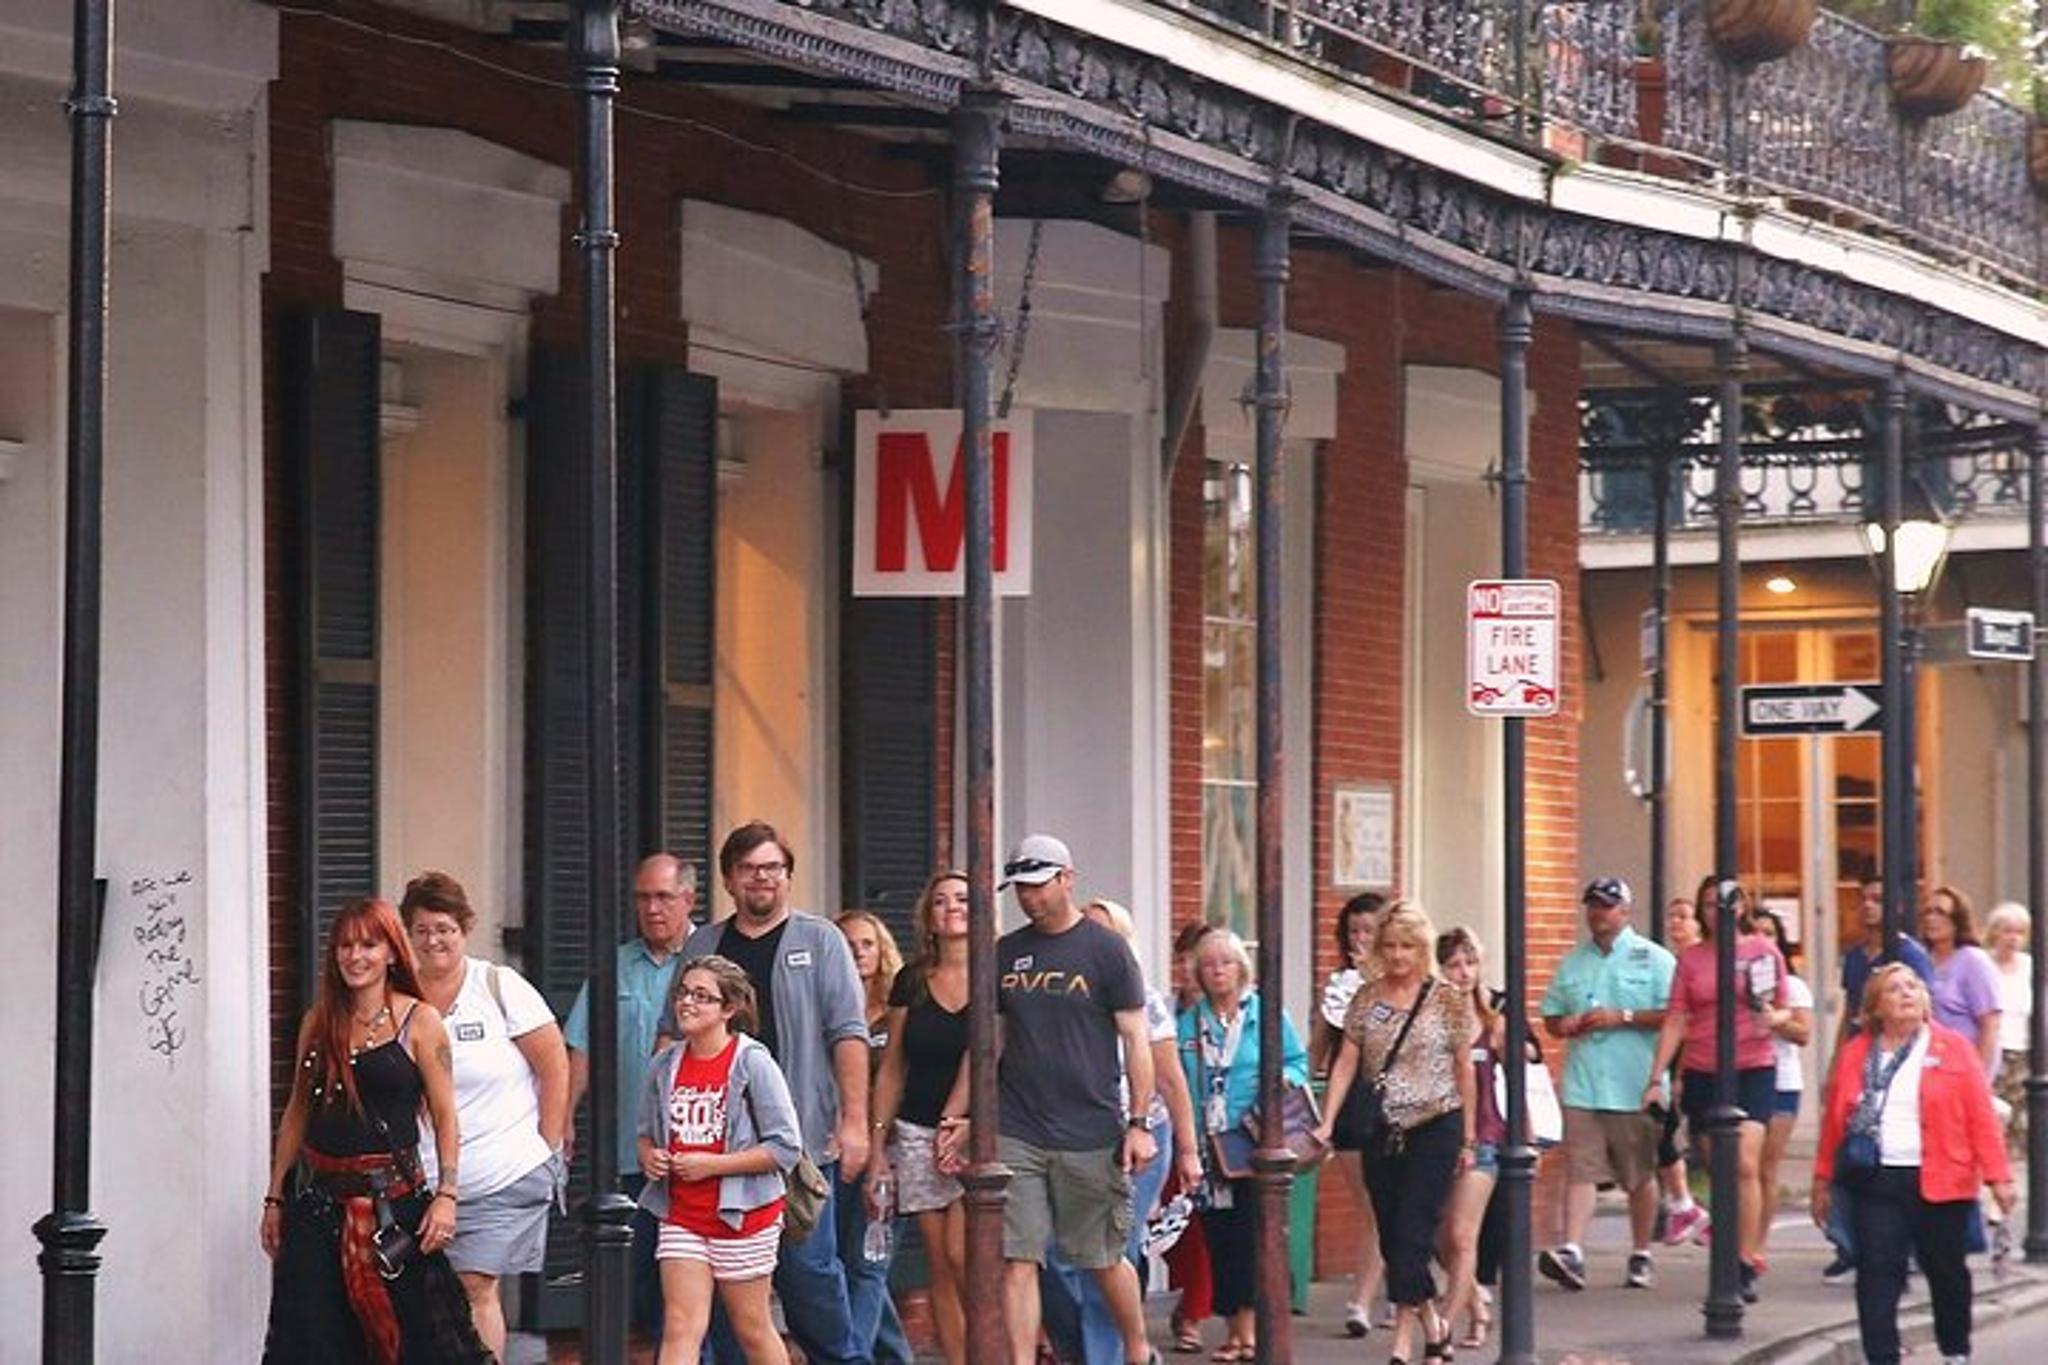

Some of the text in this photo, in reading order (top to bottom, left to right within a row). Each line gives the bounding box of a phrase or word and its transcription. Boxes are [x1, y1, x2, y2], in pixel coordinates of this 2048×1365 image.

[874, 431, 1010, 573] M
[1473, 588, 1501, 614] NO
[1490, 625, 1537, 646] FIRE
[1487, 653, 1540, 675] LANE
[1755, 700, 1842, 720] ONE WAY
[1001, 971, 1090, 999] RVCA
